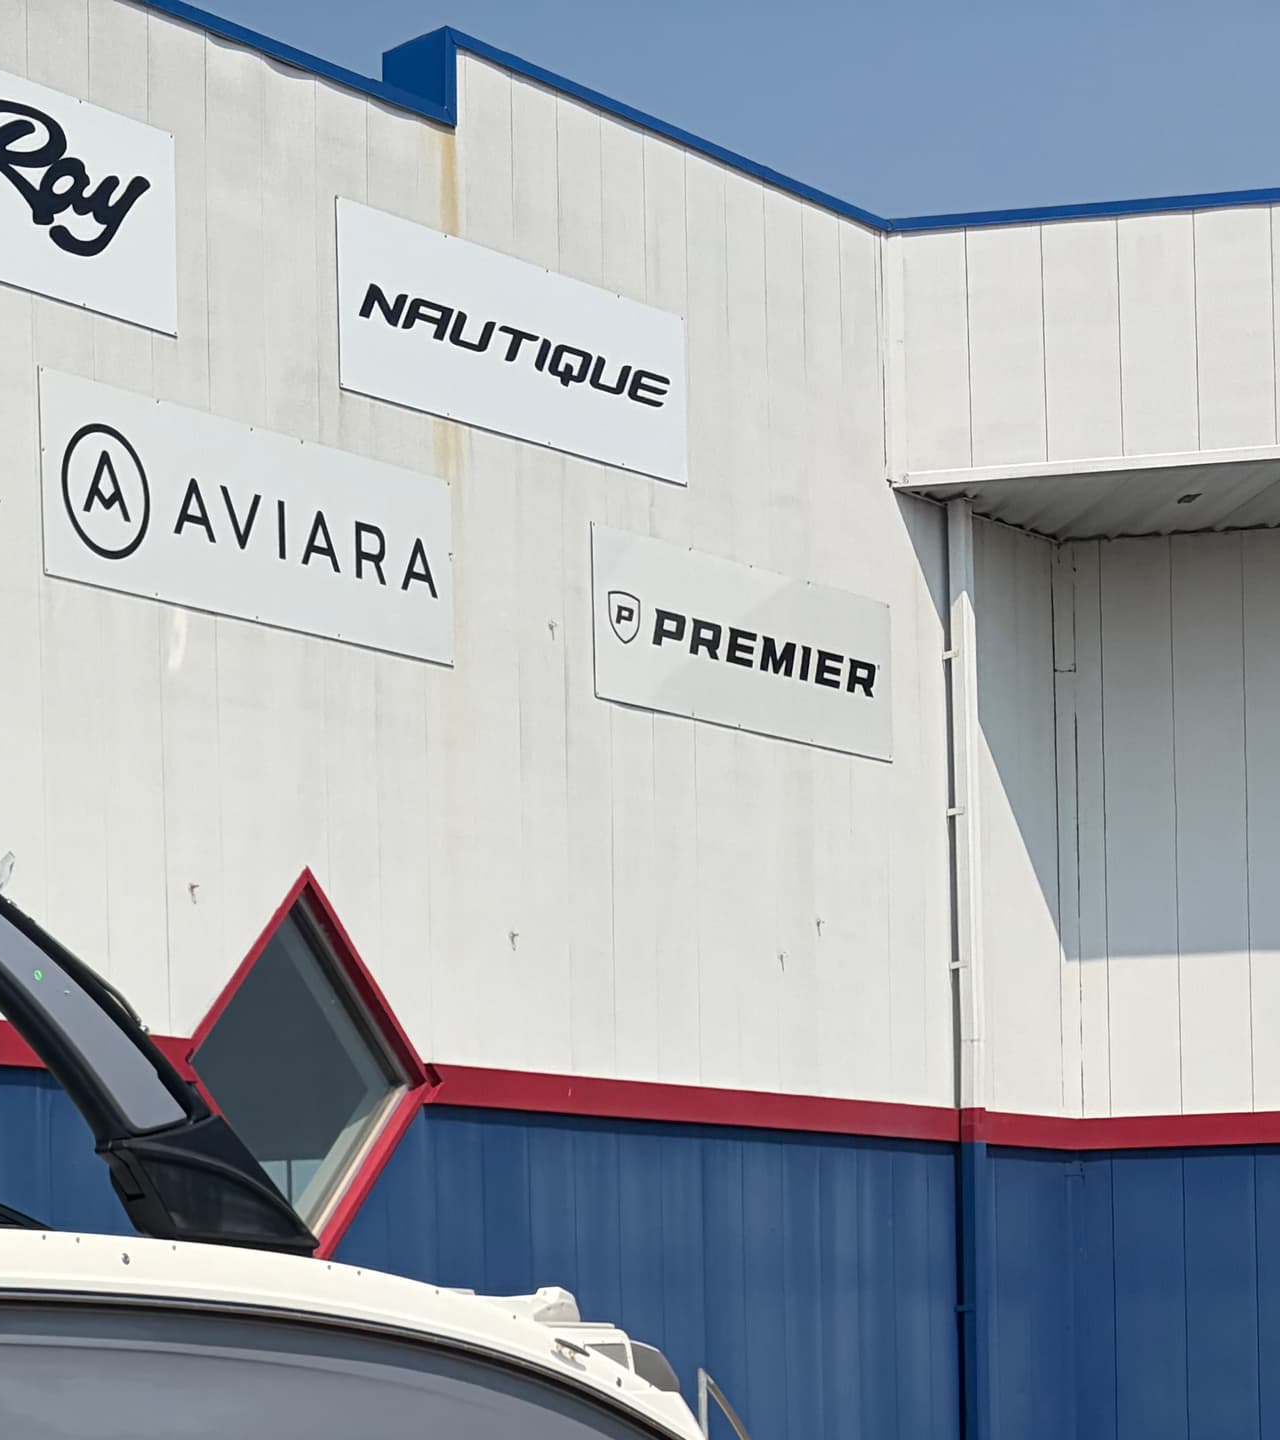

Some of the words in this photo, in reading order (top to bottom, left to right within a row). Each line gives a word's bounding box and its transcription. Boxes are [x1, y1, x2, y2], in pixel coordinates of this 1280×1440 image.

[358, 283, 671, 408] NAUTIQUE
[173, 477, 439, 599] AVIARA
[652, 608, 875, 698] PREMIER
